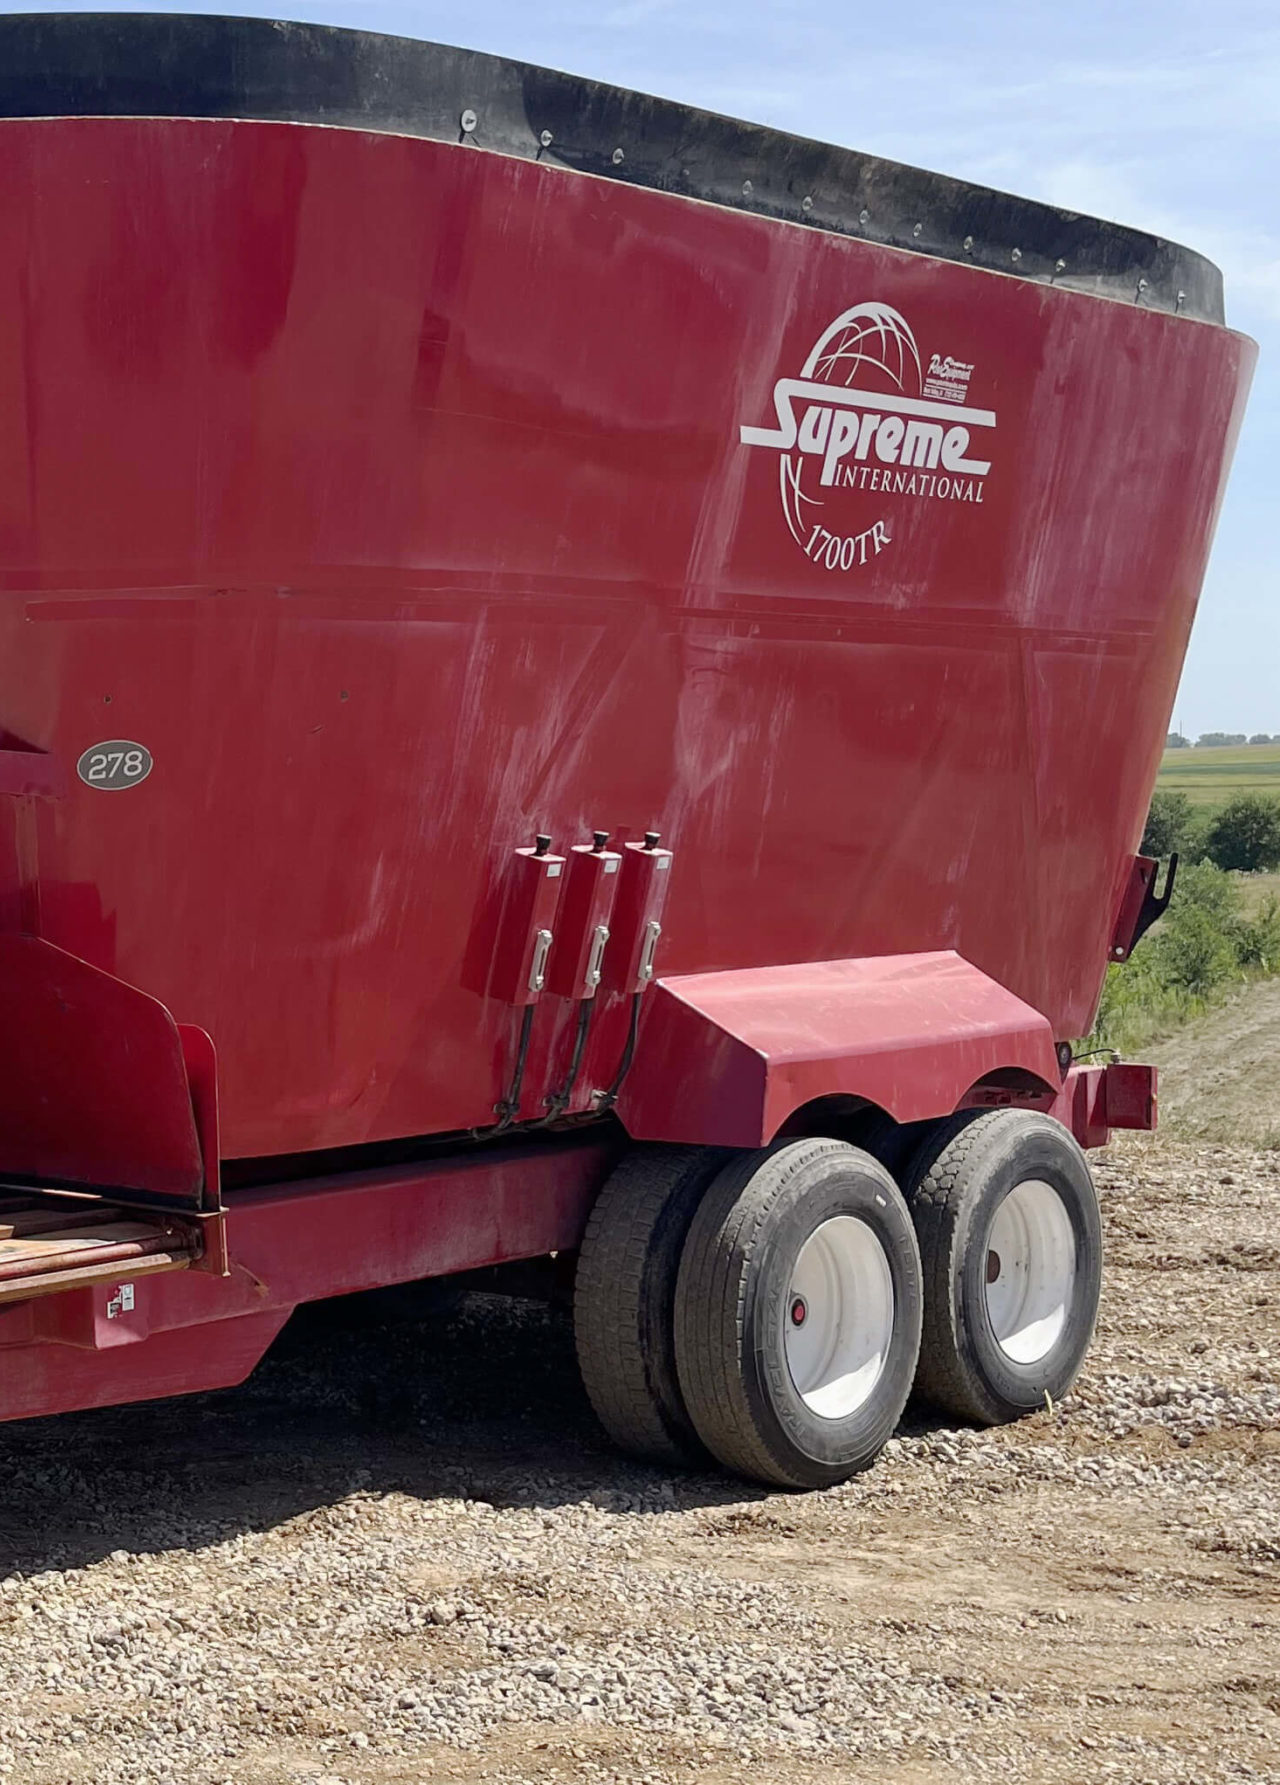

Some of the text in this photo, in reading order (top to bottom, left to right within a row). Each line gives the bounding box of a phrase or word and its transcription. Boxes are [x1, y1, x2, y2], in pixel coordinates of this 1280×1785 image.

[740, 377, 996, 487] Supreme
[835, 464, 984, 502] INTERNATIONAL
[804, 520, 892, 570] 1700TR
[88, 751, 143, 780] 278
